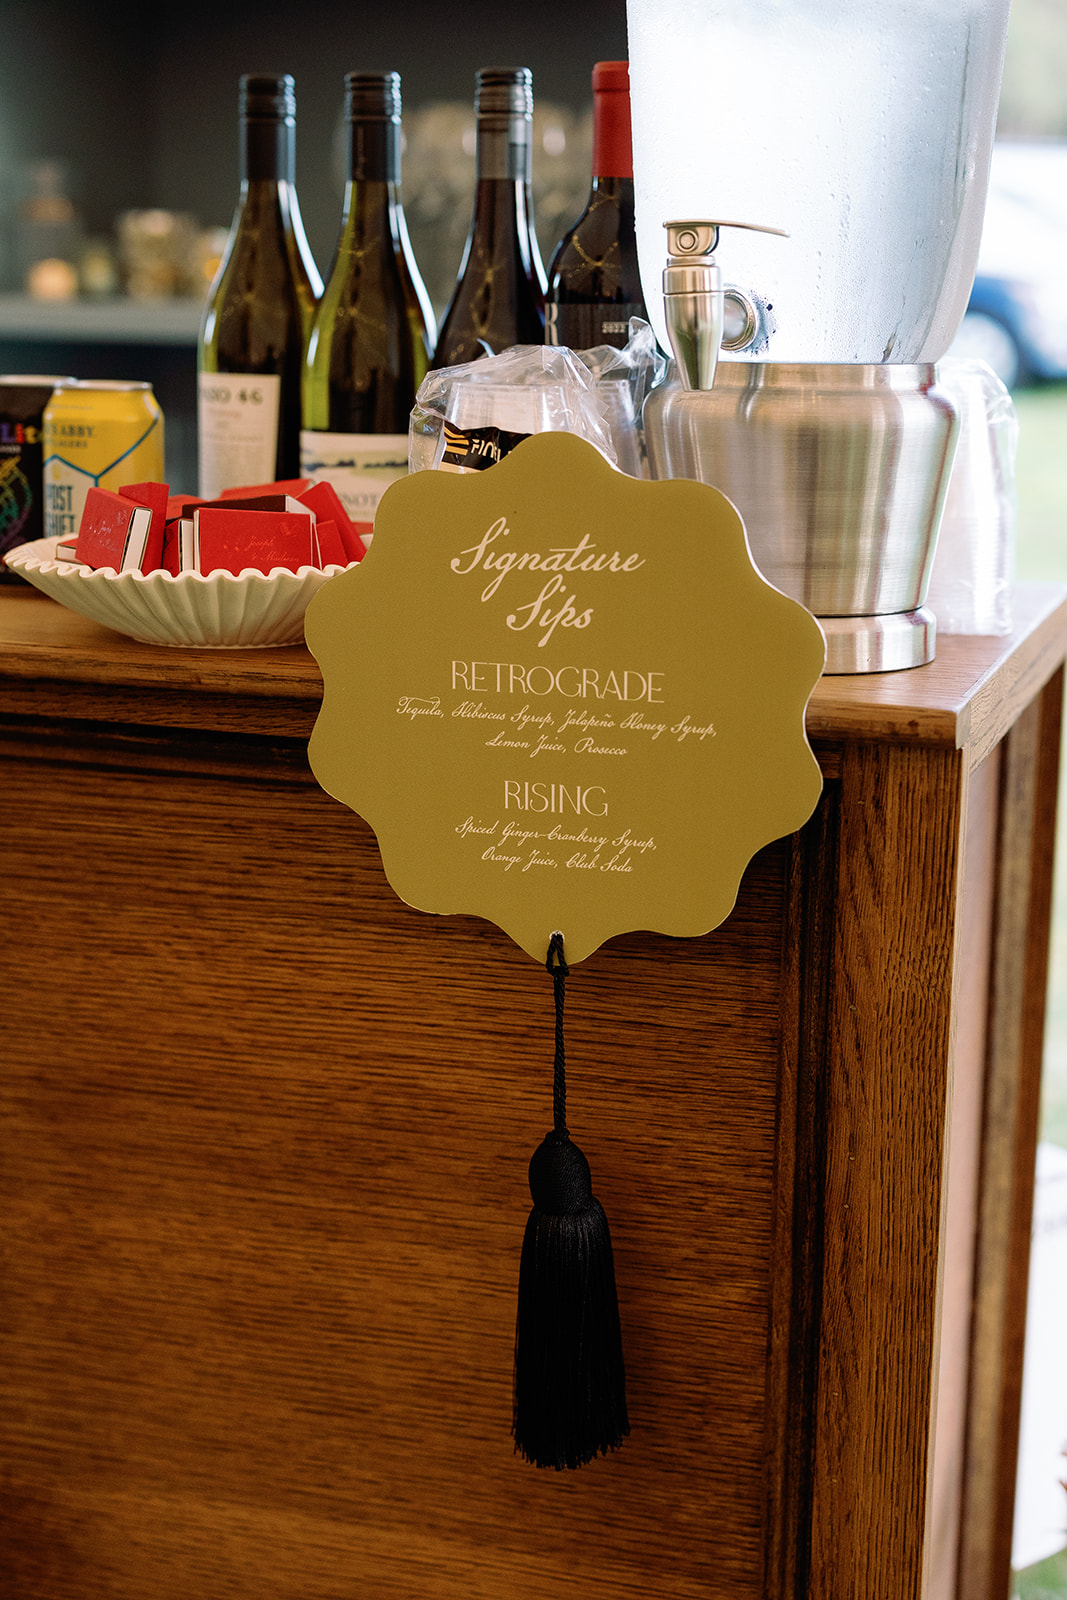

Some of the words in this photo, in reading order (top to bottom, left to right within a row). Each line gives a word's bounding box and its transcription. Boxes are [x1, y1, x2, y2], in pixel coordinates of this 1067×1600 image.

[451, 517, 646, 602] Signature
[506, 574, 594, 647] Sips
[451, 660, 665, 704] RETROGRADE
[396, 696, 445, 719] Tequila,
[452, 701, 506, 721] Hibiscus
[510, 705, 555, 732] Syrup,
[560, 709, 615, 733] Jalapeño
[619, 712, 667, 740] Honey
[670, 715, 717, 743] Syrup,
[485, 731, 530, 748] Lemon
[530, 734, 567, 758] Juice,
[574, 737, 628, 756] Prosecco
[504, 780, 609, 816] RISING
[455, 816, 499, 838] Spiced
[612, 829, 657, 854] Syrup,
[481, 846, 522, 872] Orange
[522, 849, 558, 872] Juice,
[565, 852, 598, 869] Club
[600, 854, 633, 873] Soda
